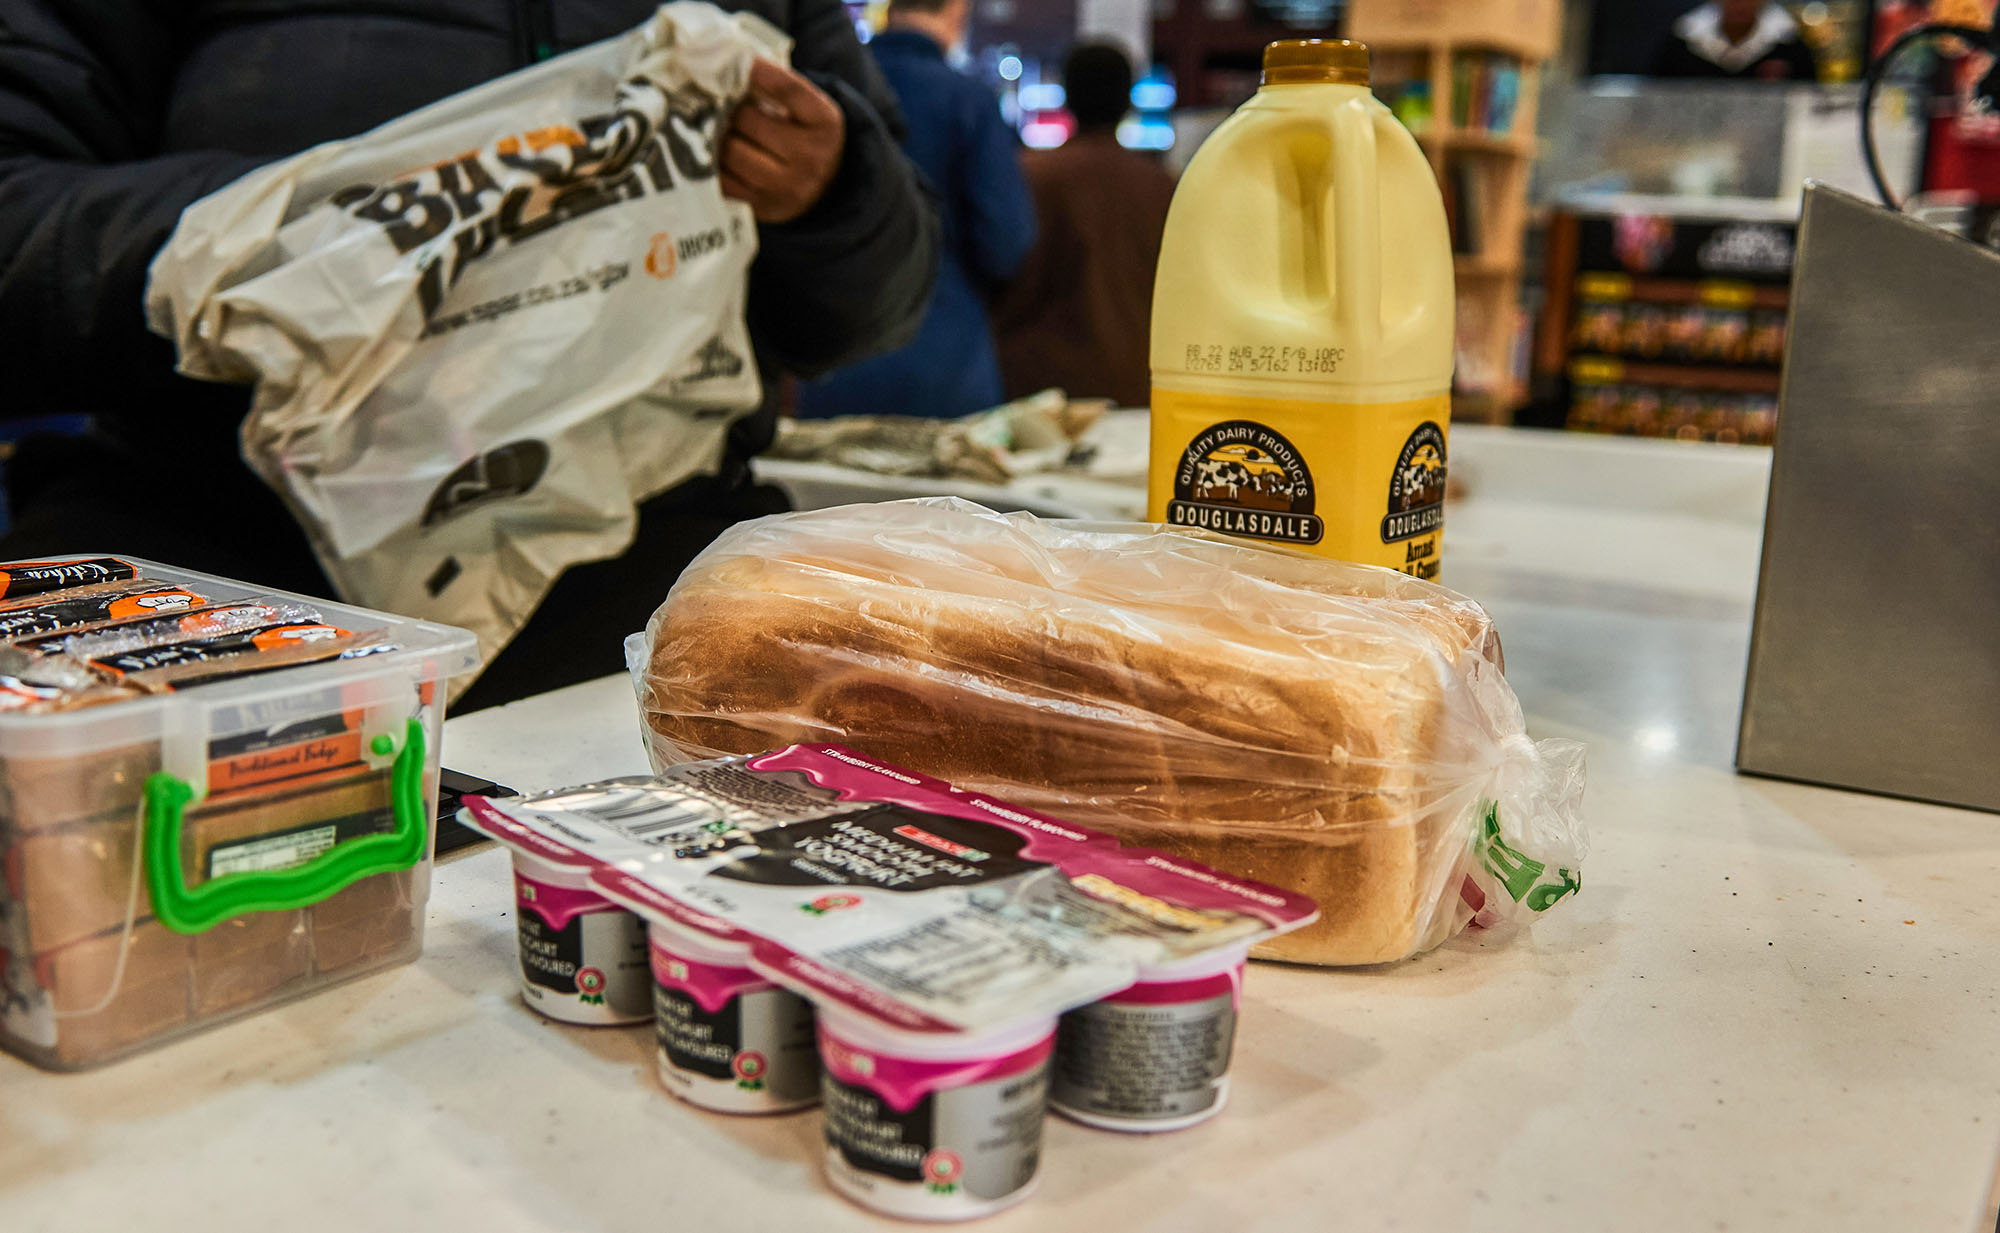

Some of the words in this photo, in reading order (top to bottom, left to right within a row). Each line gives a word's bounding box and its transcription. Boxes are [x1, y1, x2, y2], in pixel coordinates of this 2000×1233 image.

[1209, 345, 1223, 359] 22
[1230, 346, 1252, 360] AUG
[1259, 346, 1276, 359] 22
[1298, 361, 1337, 373] 13:03
[1182, 434, 1214, 485] QUALITY
[1217, 427, 1256, 442] DAIRY
[1259, 432, 1308, 497] PRODUCTS
[1176, 505, 1311, 538] DOUGLASDALE
[25, 562, 110, 585] Kitchen
[821, 748, 872, 770] STRAWBERRY
[870, 764, 921, 785] FLAVOURED
[970, 799, 1033, 826] STRAWBERRY
[1027, 817, 1088, 842] FLAVOURED
